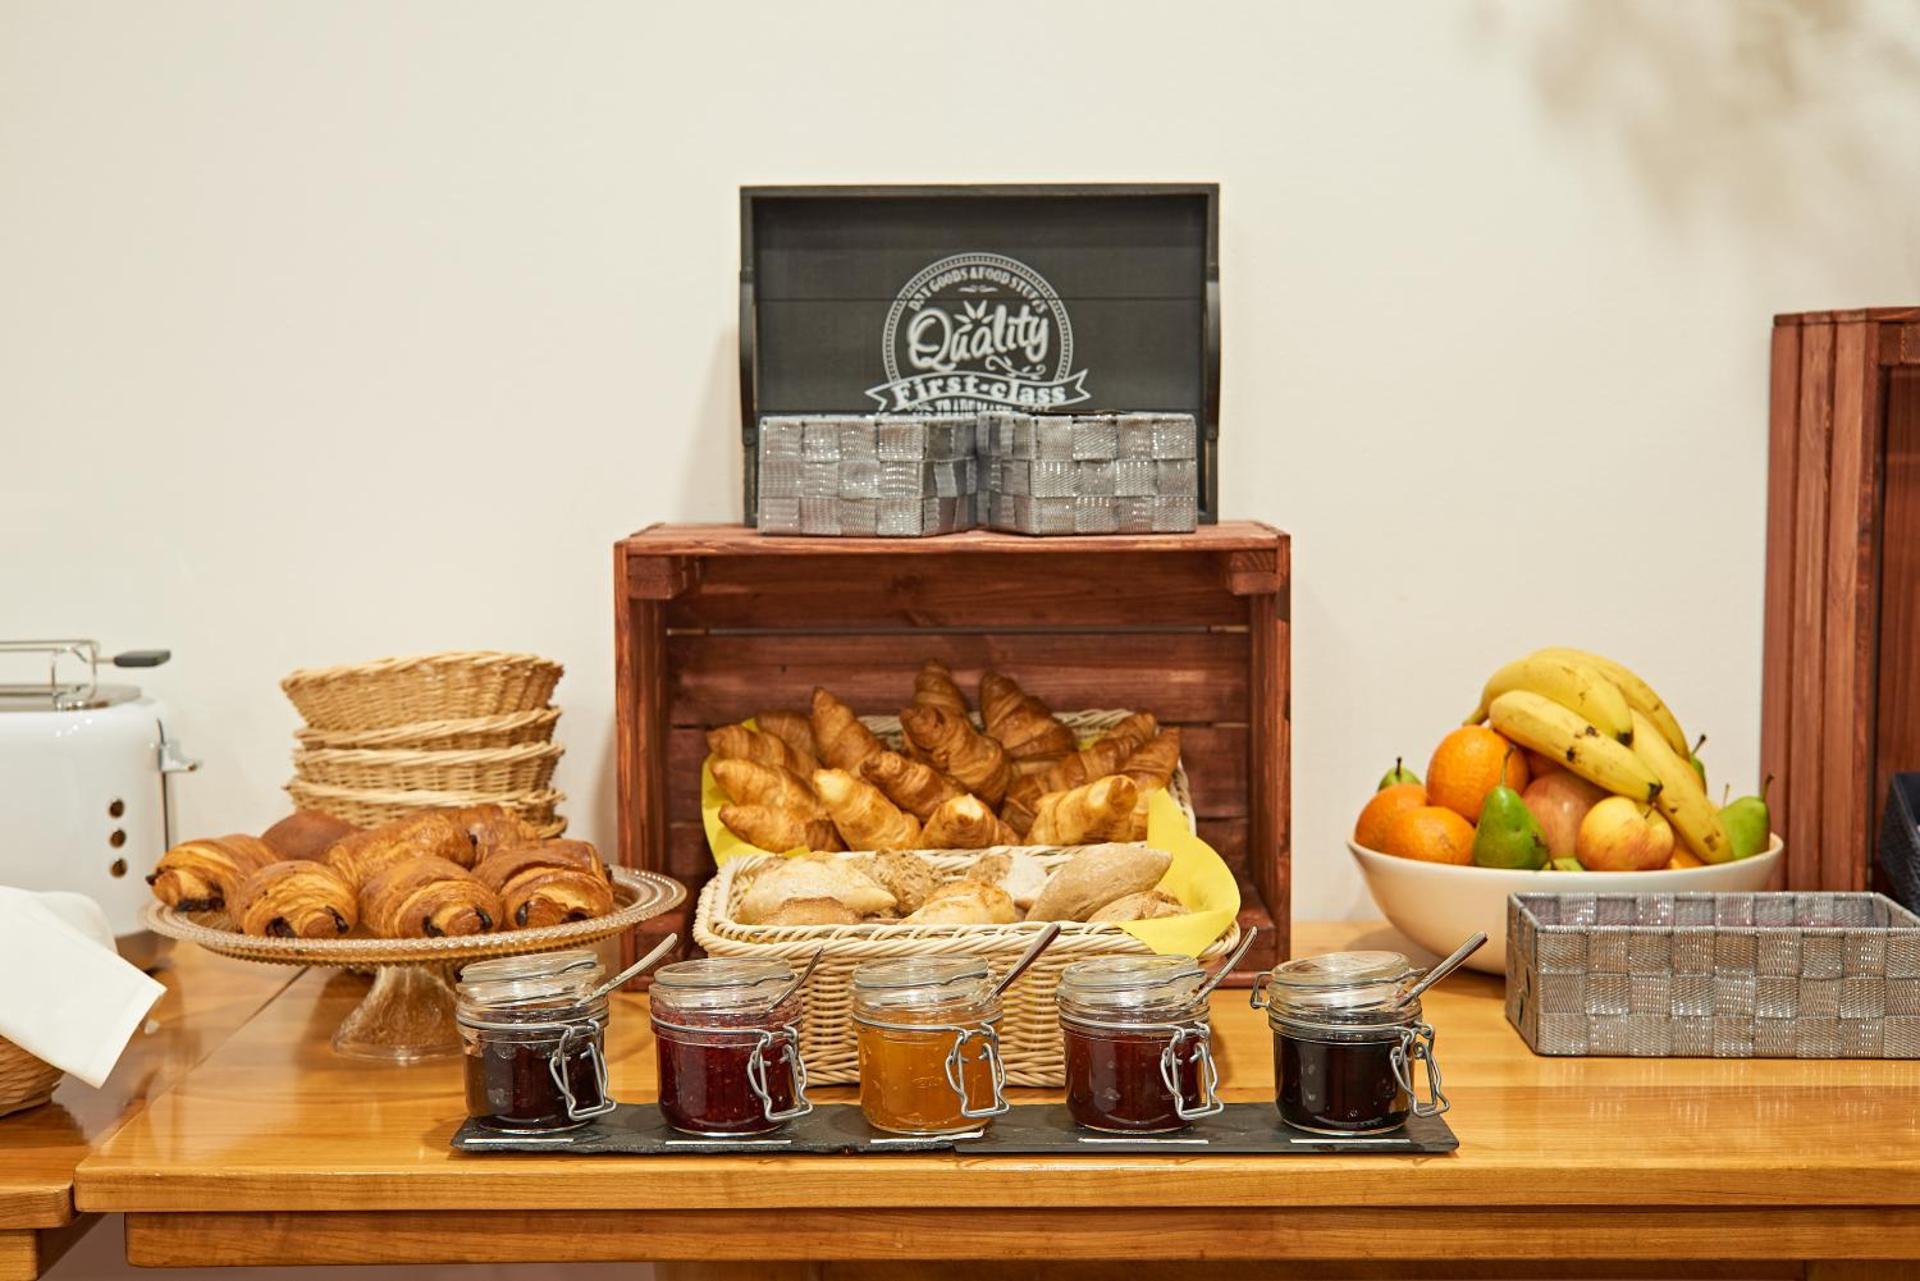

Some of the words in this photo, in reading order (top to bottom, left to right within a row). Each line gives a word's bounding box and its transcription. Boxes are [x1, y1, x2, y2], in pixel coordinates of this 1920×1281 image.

[931, 267, 968, 291] GOODS
[907, 304, 1049, 372] Quality
[891, 375, 1067, 411] First-class
